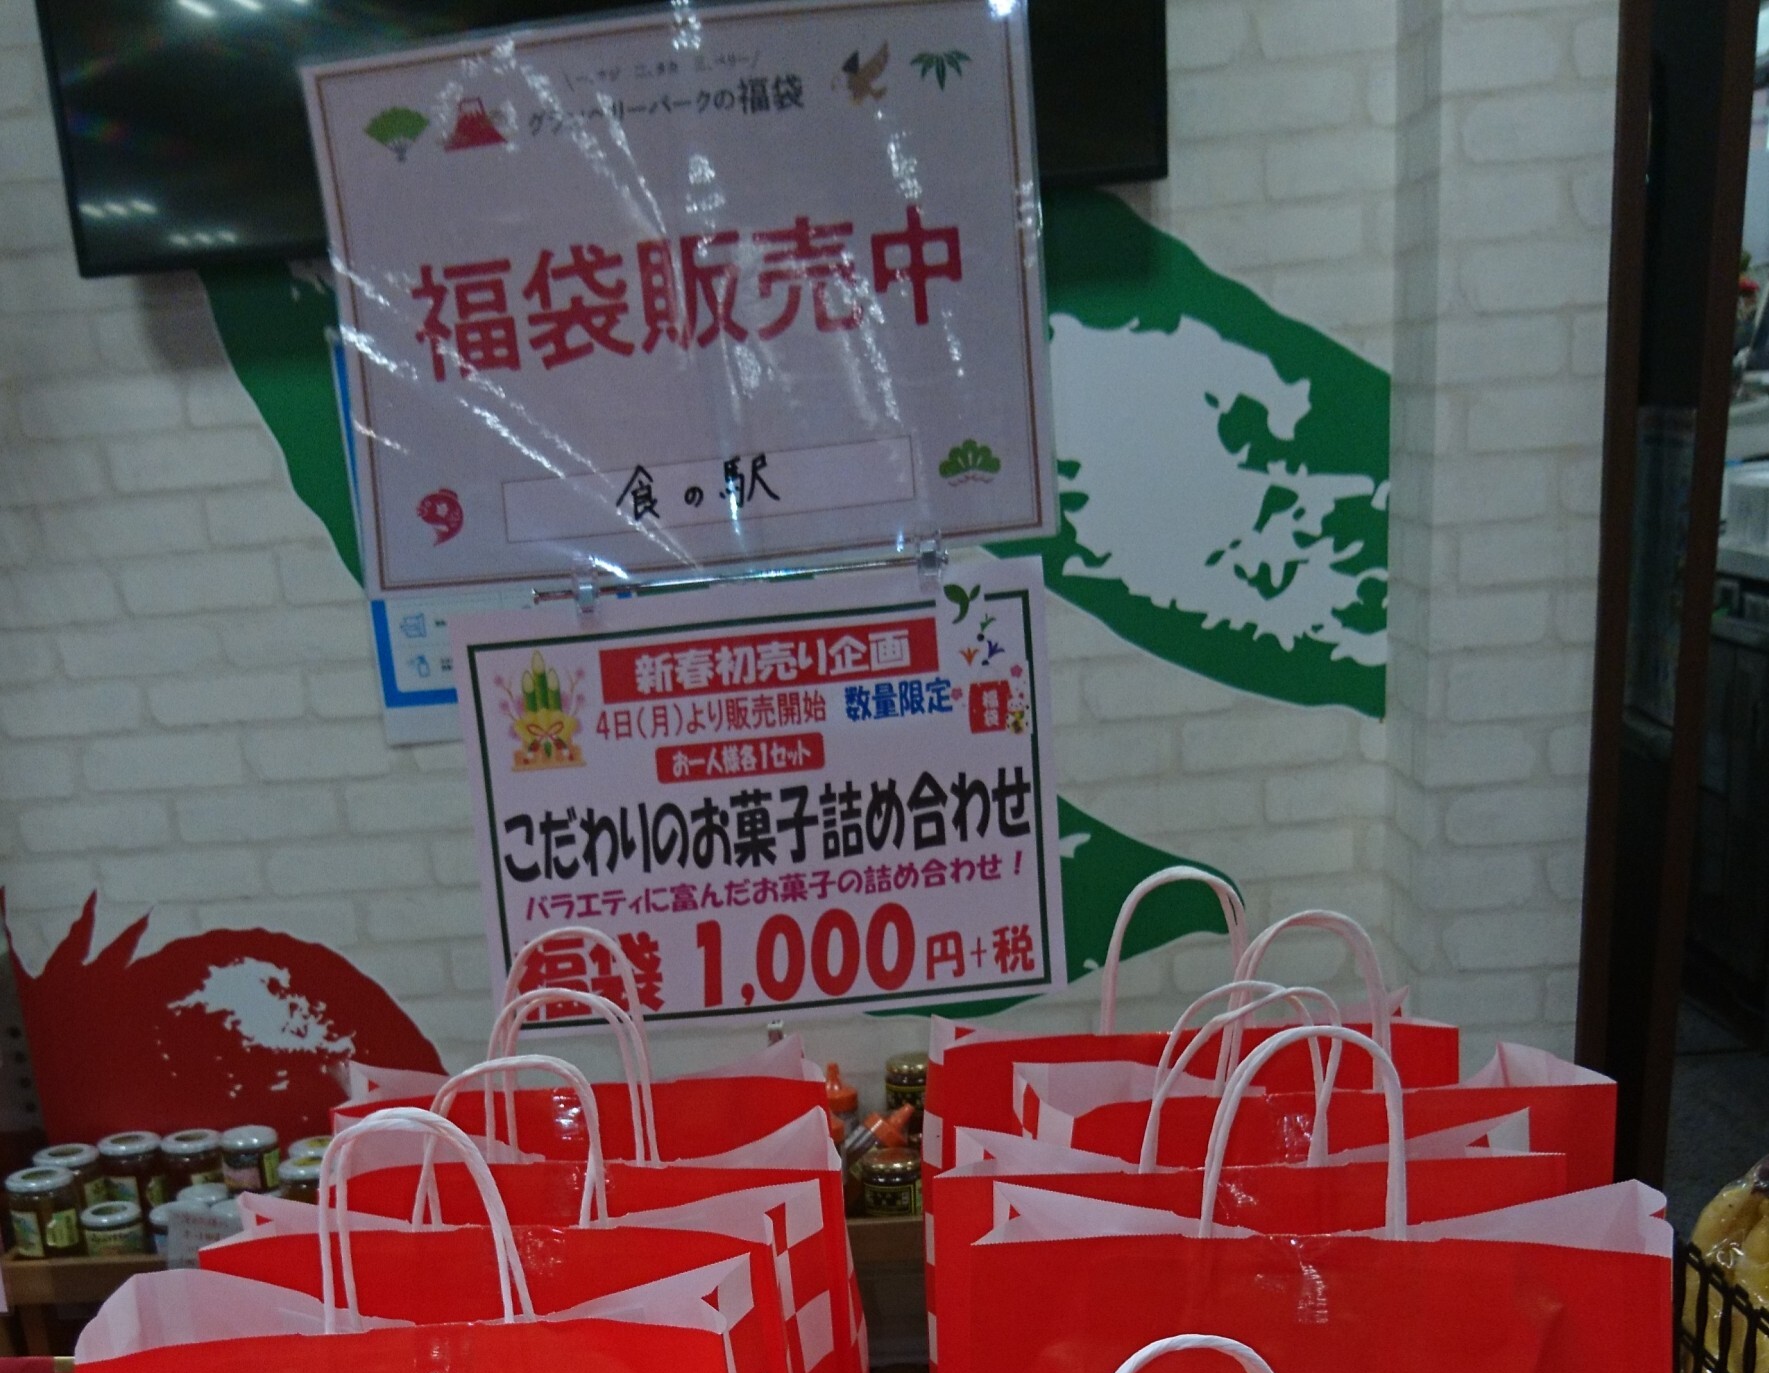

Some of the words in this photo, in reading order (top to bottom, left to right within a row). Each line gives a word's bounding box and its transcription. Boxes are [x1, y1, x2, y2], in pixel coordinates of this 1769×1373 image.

[411, 203, 963, 382] 福袋販売中
[615, 452, 782, 521] 食の駅
[634, 628, 912, 695] 新春初売り企画
[596, 689, 828, 741] 4日(月)より販売開始
[844, 676, 954, 723] 数量限定
[671, 739, 813, 778] お一人様各1セット
[503, 765, 1032, 883] こだわりのお菓子詰め合わせ
[525, 850, 1024, 921] バラエティに富んだお菓子の詰め合わせ！
